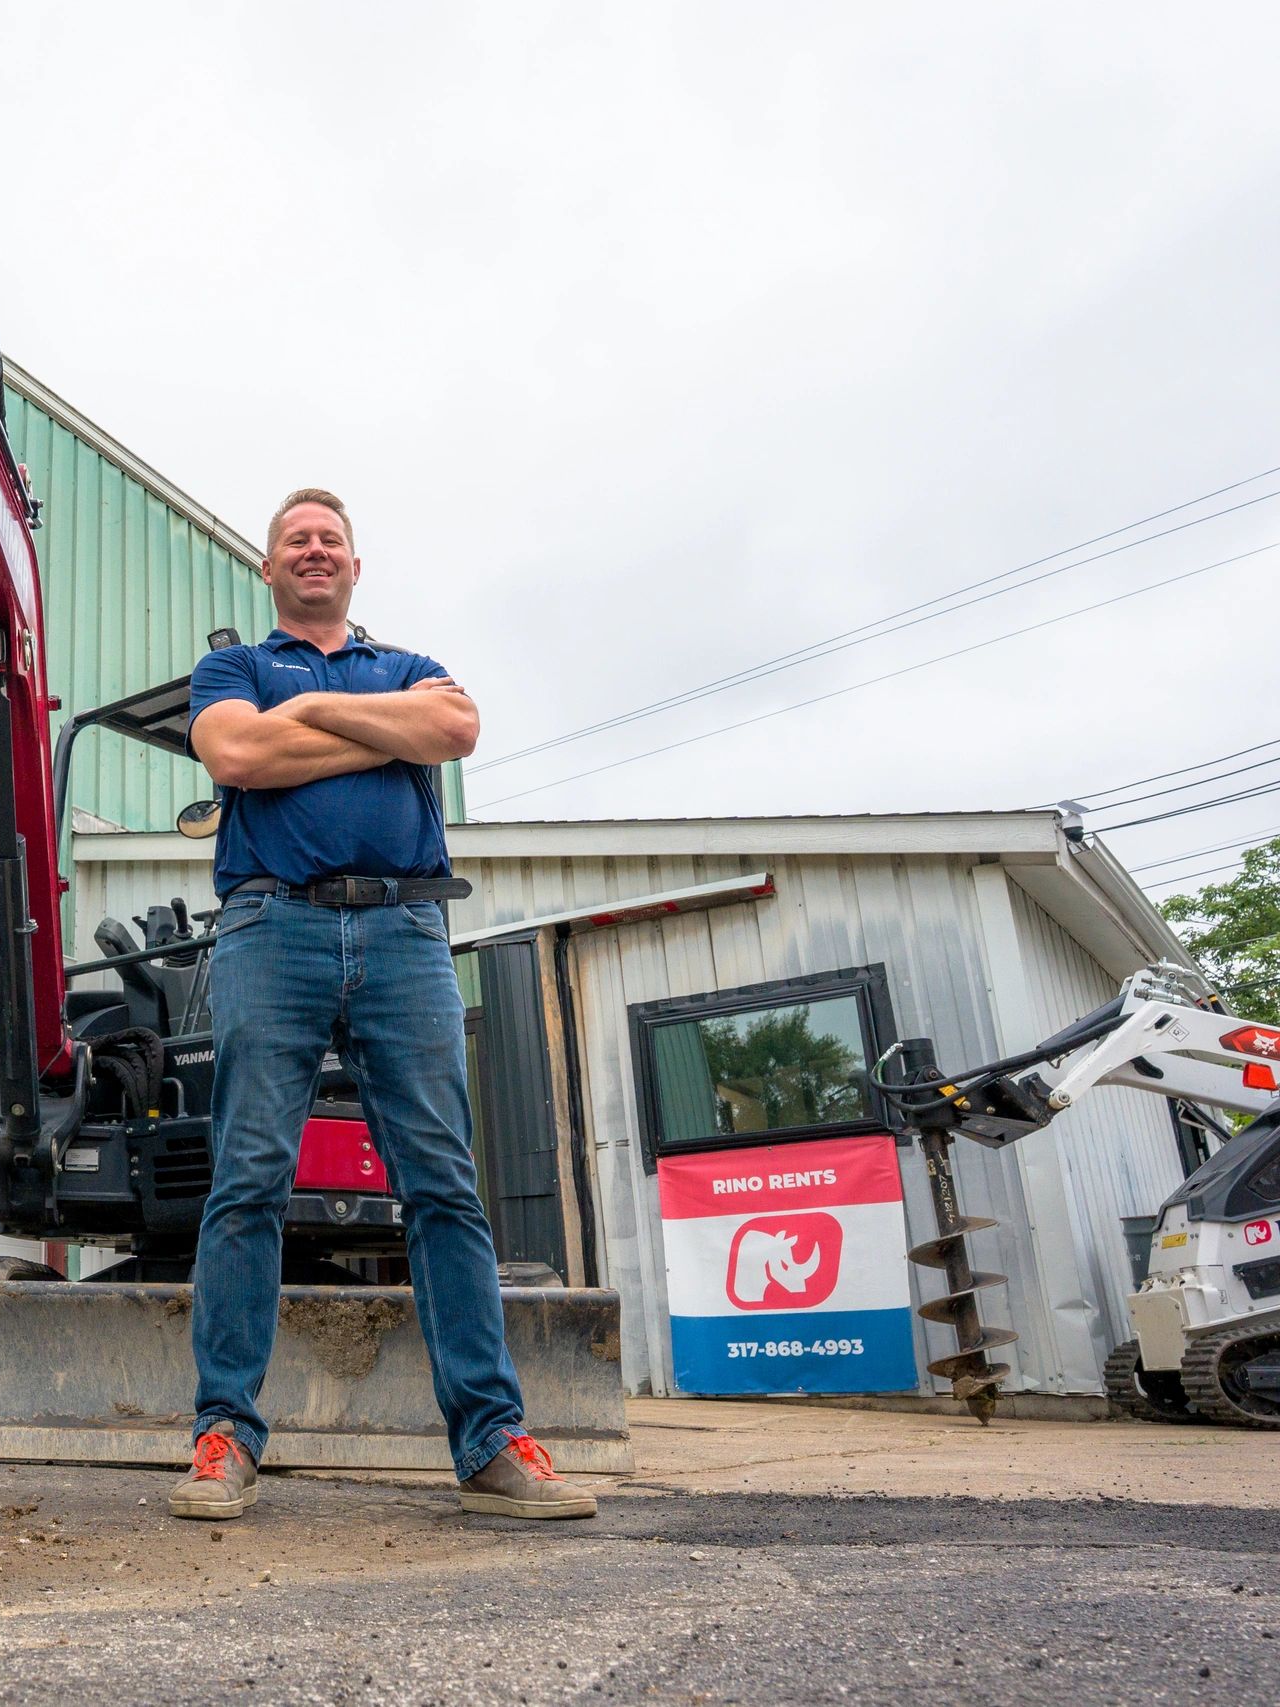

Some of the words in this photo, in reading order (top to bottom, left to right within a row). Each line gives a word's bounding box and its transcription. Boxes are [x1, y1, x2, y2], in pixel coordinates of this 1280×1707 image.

[712, 1176, 763, 1194] RINO
[768, 1169, 837, 1189] RENTS
[727, 1339, 865, 1358] 317-868-4993
